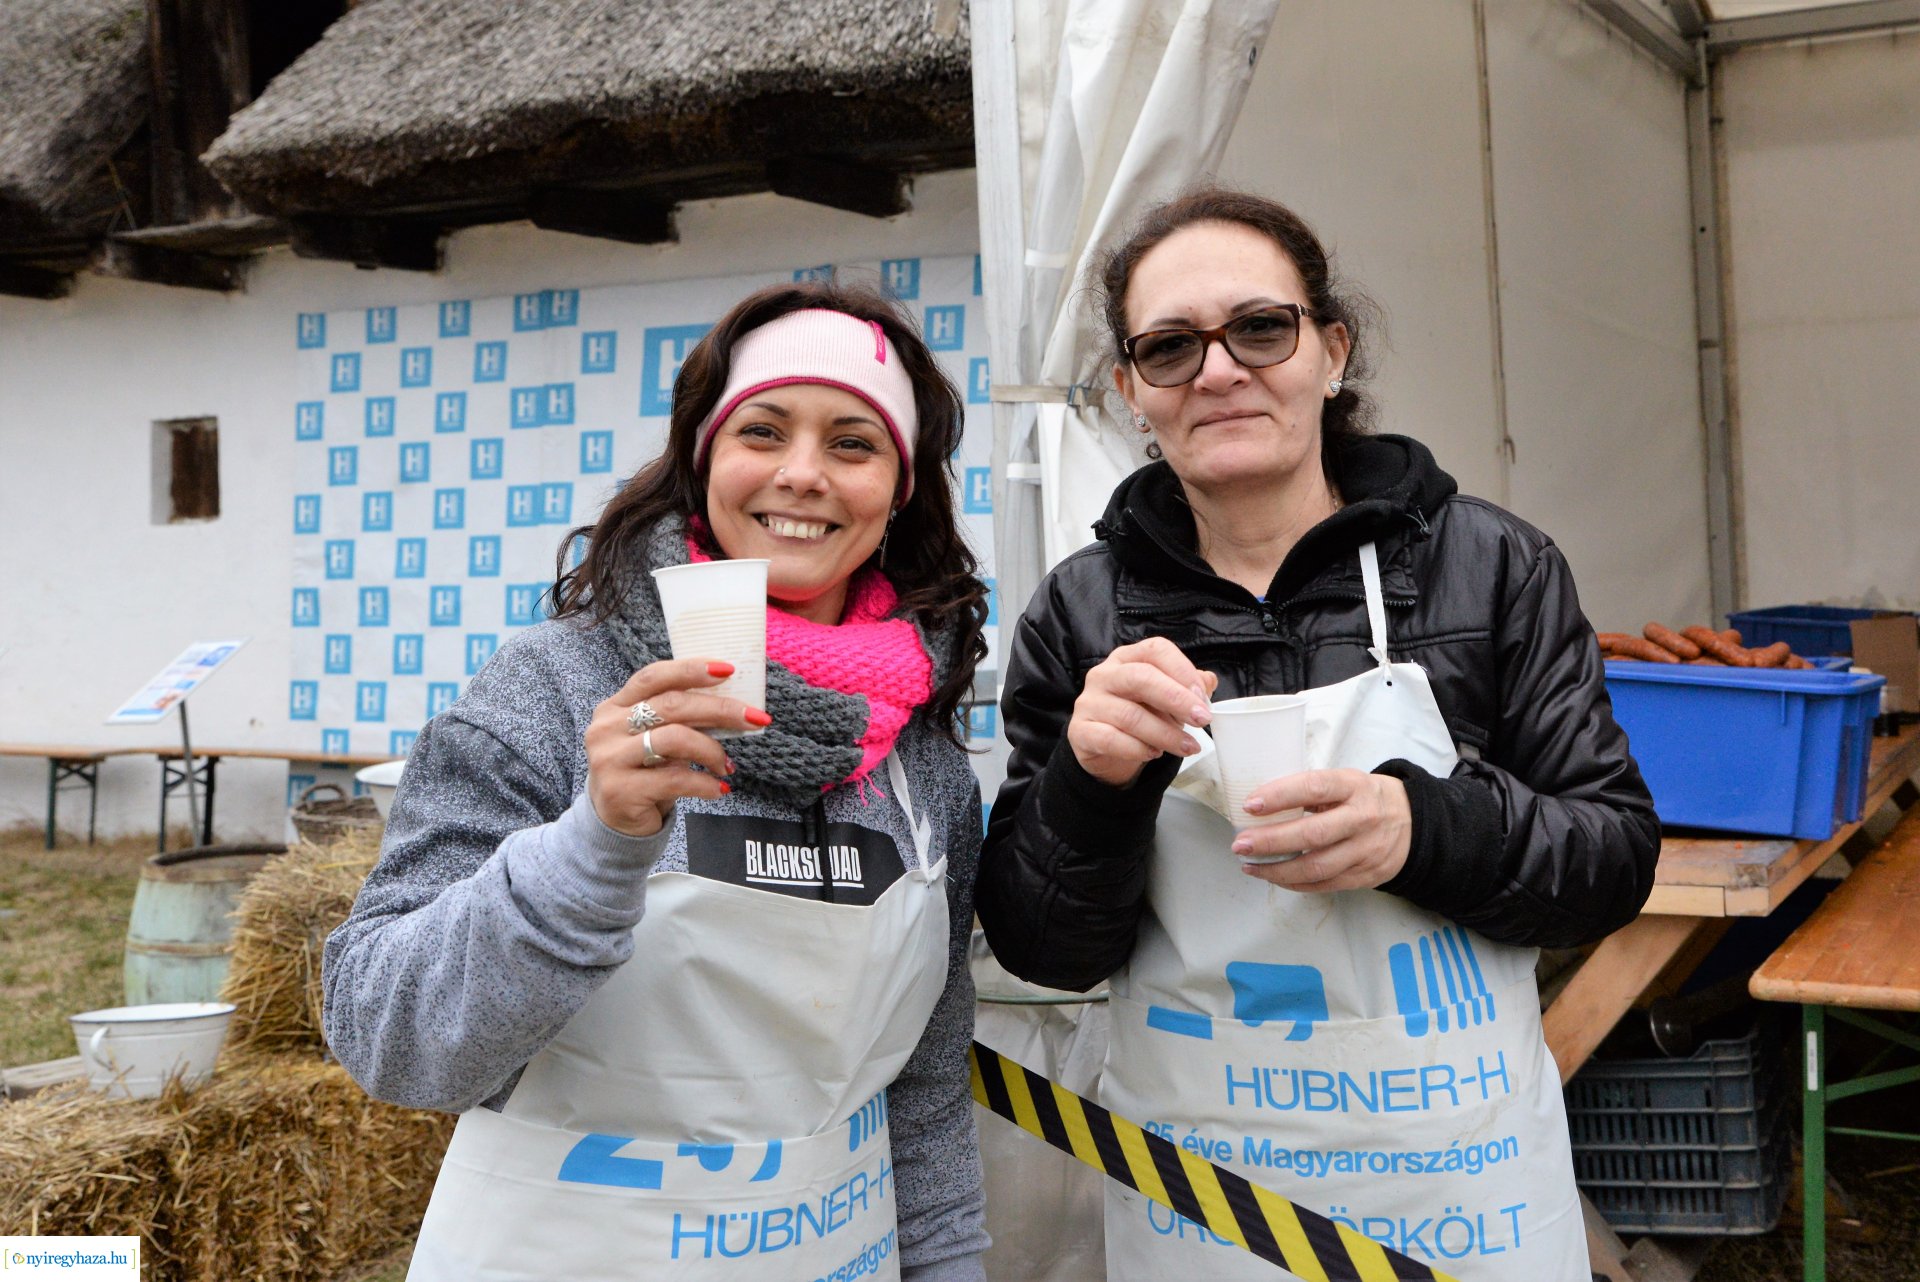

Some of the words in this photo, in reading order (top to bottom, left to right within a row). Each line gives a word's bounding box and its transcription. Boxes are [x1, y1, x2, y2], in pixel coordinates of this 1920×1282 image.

[1225, 1050, 1511, 1114] HÜBNER-H
[1181, 1127, 1233, 1163] éve
[1242, 1135, 1519, 1179] Magyarországon
[670, 1157, 893, 1260] HÜBNER-H
